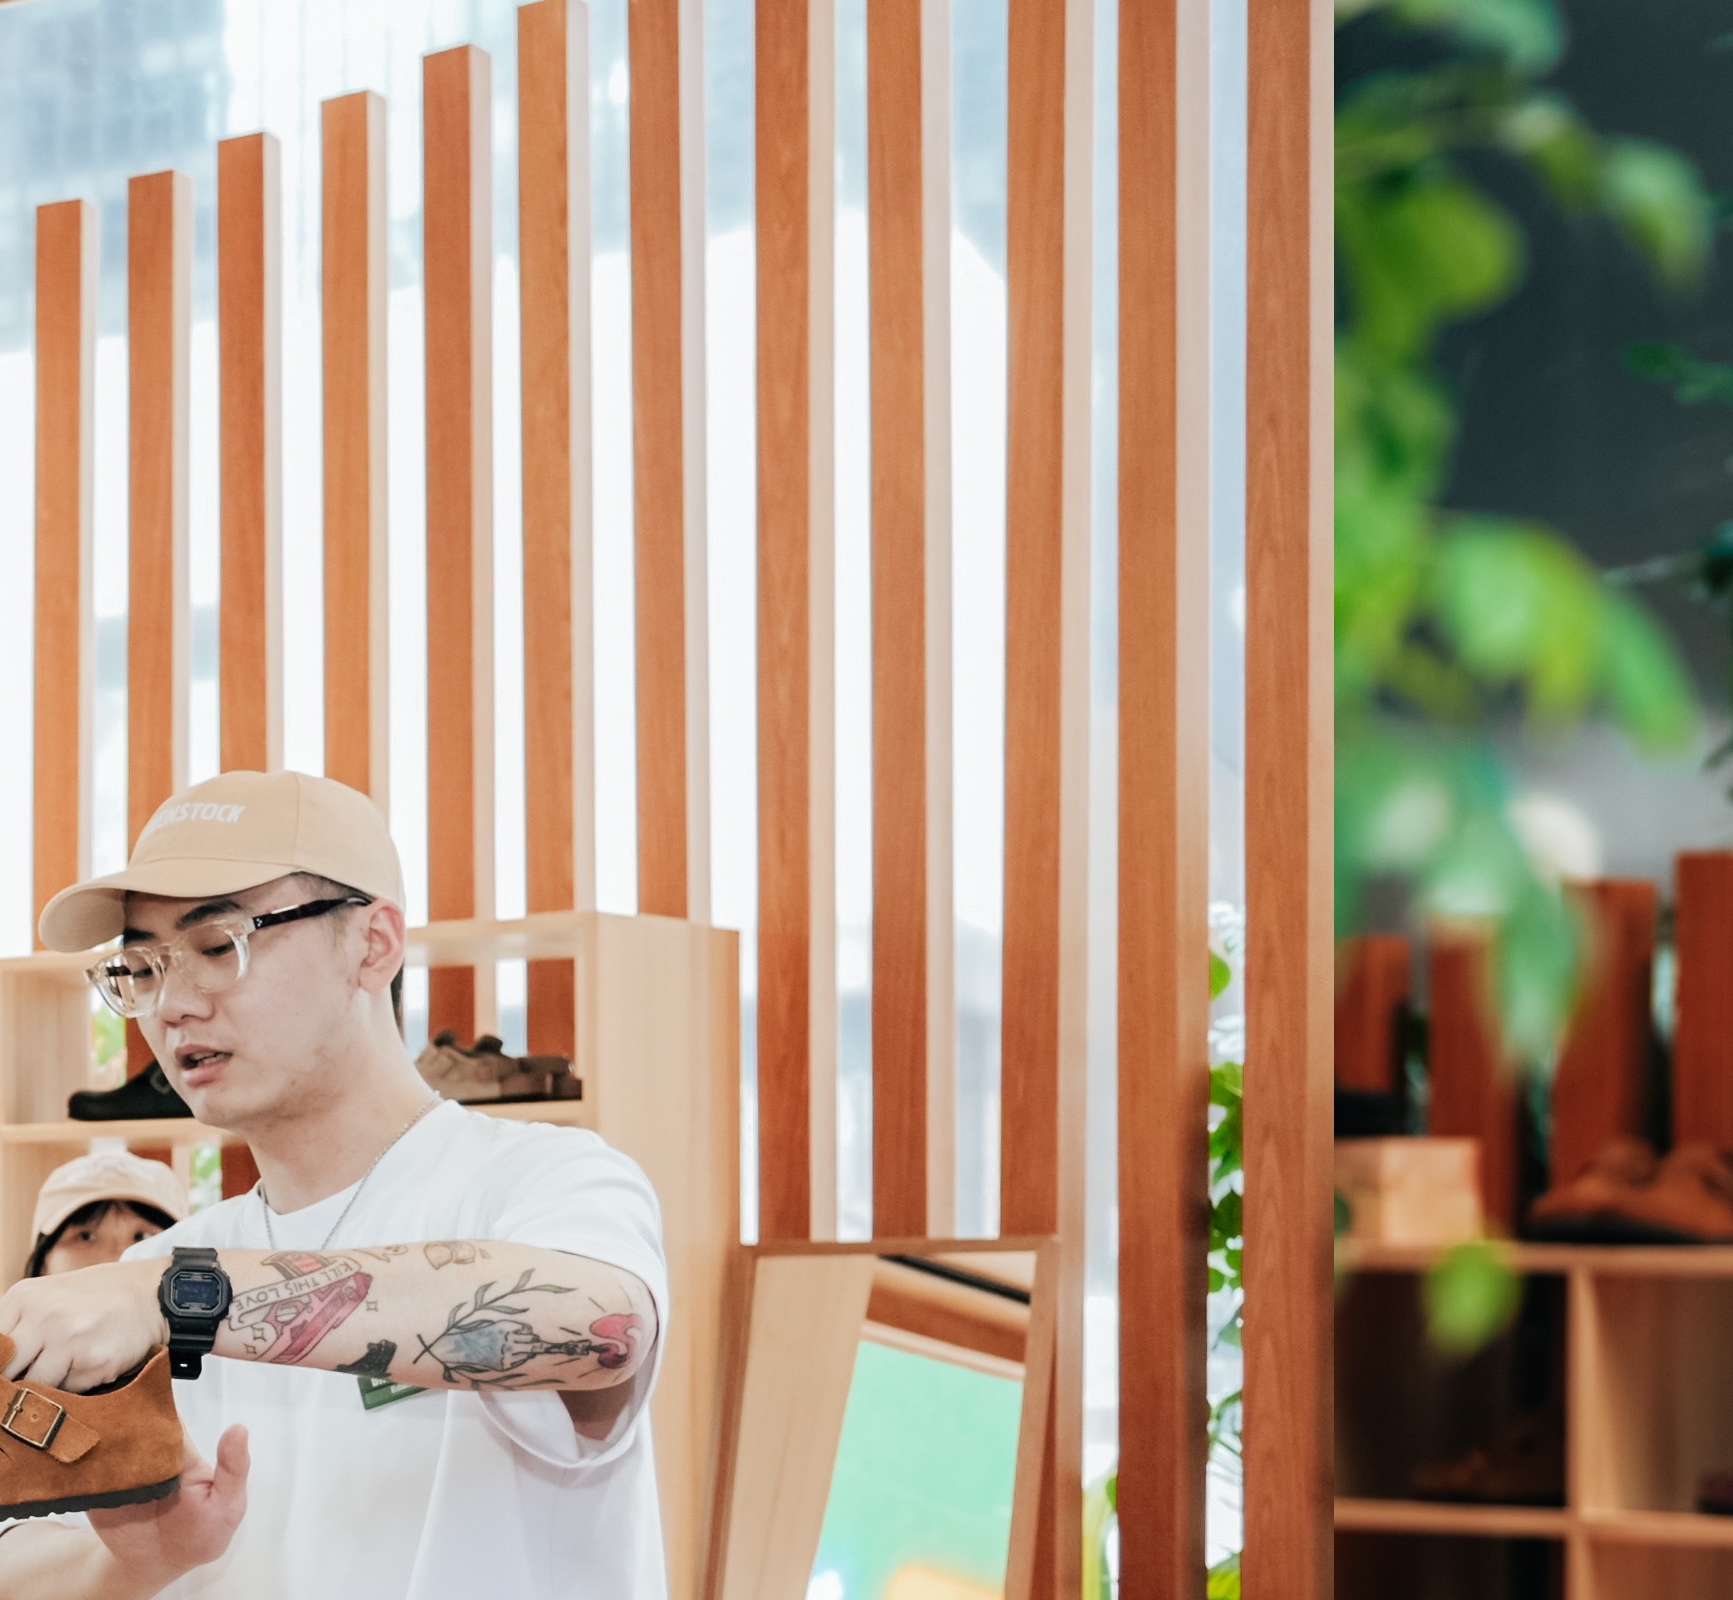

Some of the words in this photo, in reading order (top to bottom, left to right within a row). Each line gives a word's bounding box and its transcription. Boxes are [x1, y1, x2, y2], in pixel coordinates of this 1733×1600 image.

[320, 1260, 354, 1281] KILL
[283, 1276, 320, 1296] THIS
[233, 1286, 281, 1312] LOVE
